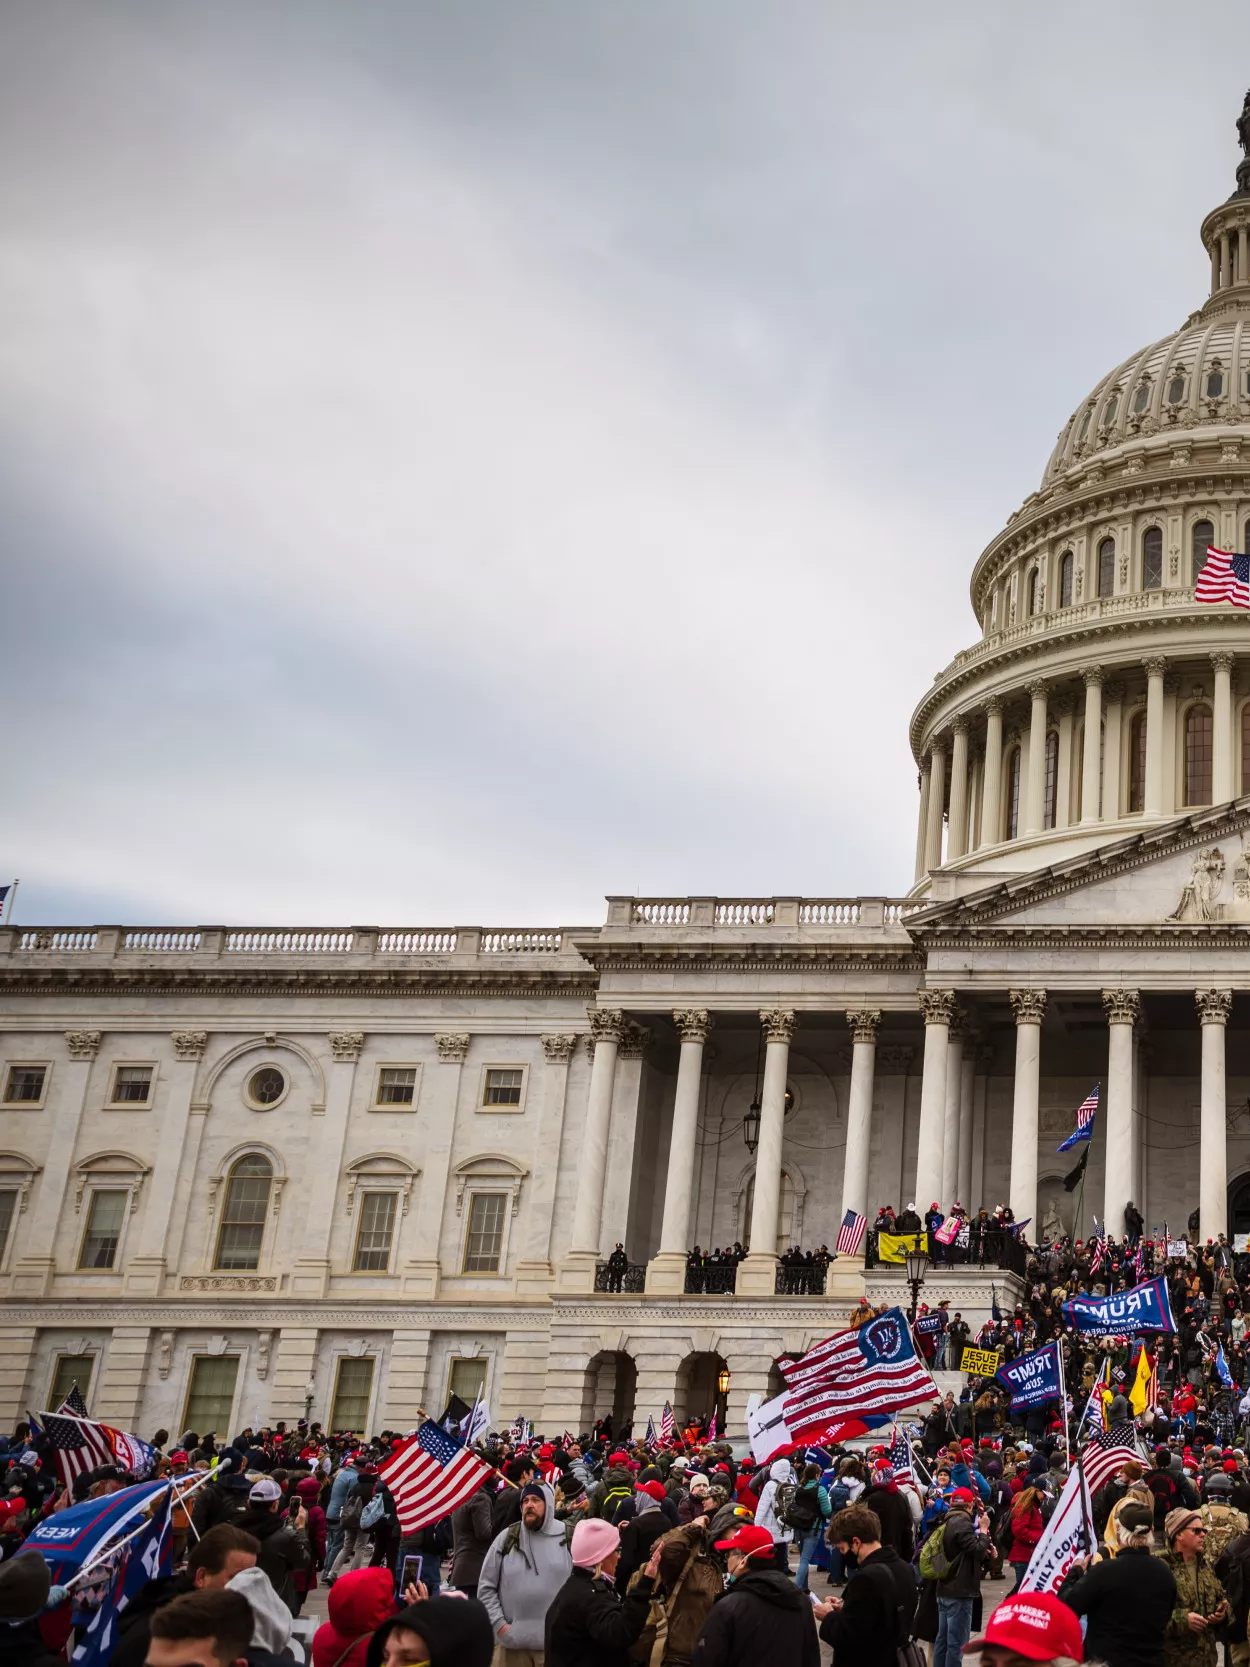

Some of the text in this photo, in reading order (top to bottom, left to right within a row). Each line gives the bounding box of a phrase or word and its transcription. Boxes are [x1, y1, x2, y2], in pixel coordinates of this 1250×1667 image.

[964, 1350, 997, 1365] JESUS
[961, 1360, 995, 1375] SAVES
[1012, 1603, 1051, 1621] AMERICA
